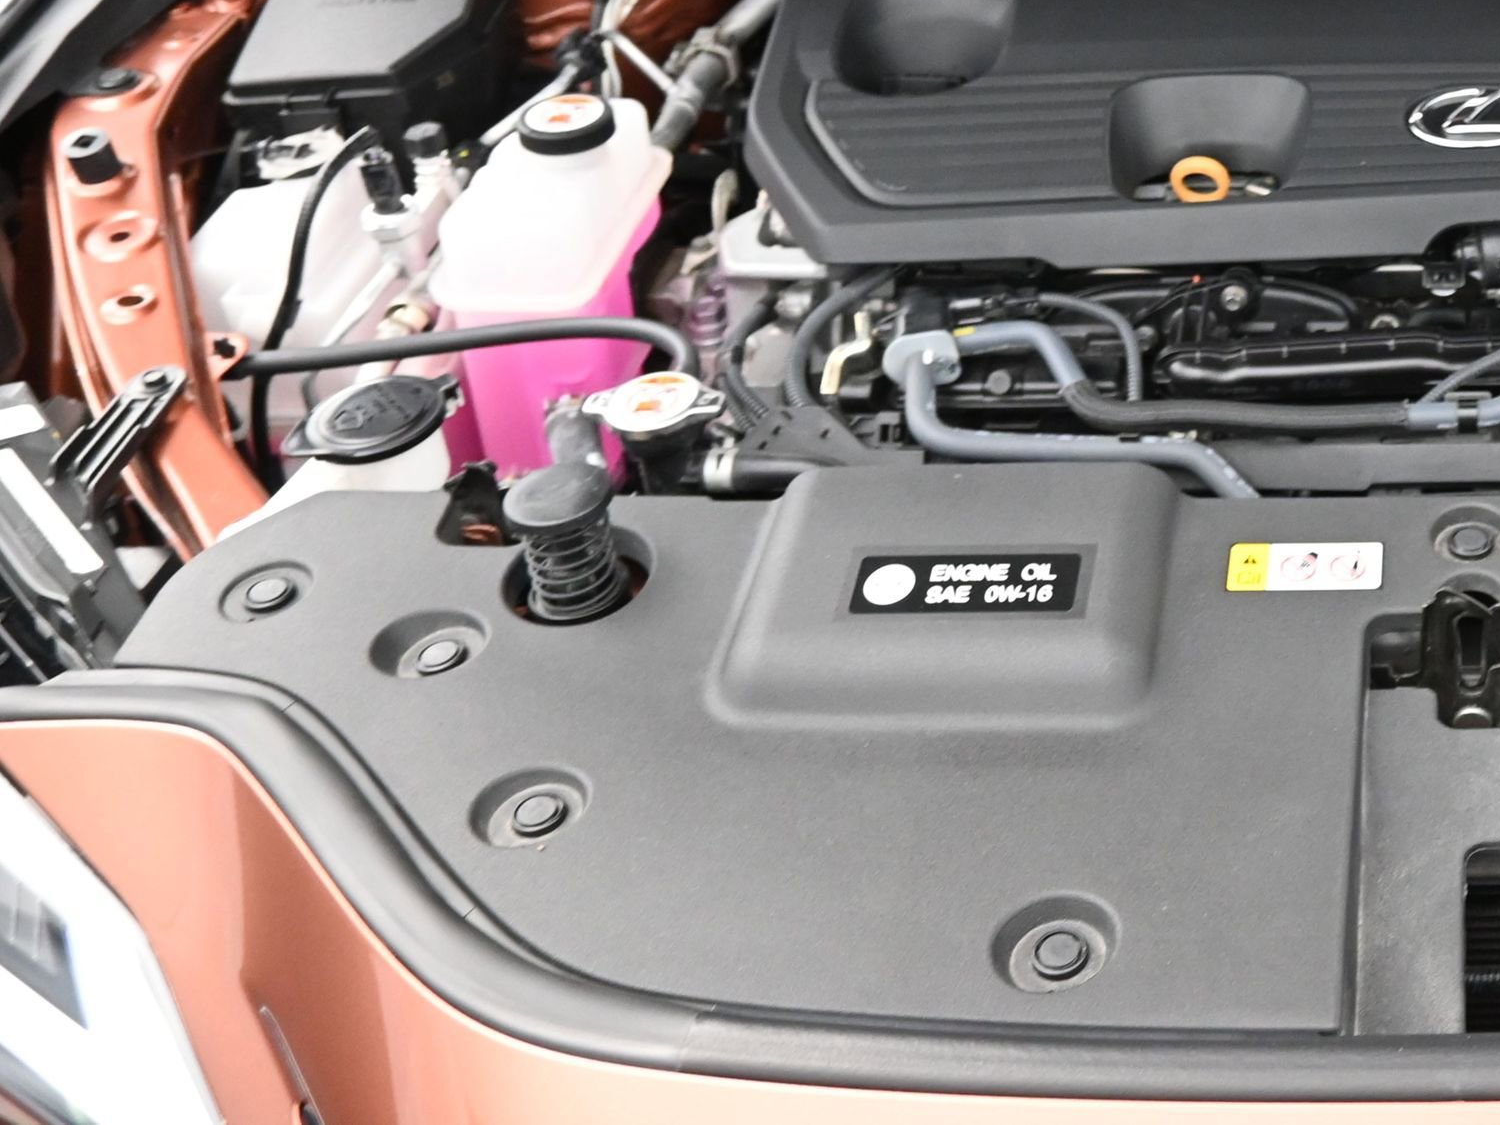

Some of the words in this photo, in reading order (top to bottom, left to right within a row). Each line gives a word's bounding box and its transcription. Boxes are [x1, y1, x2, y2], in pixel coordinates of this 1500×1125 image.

[929, 563, 1010, 582] ENGINE
[1021, 563, 1057, 581] OIL
[924, 584, 972, 604] SAE
[984, 584, 1053, 602] 0W-16
